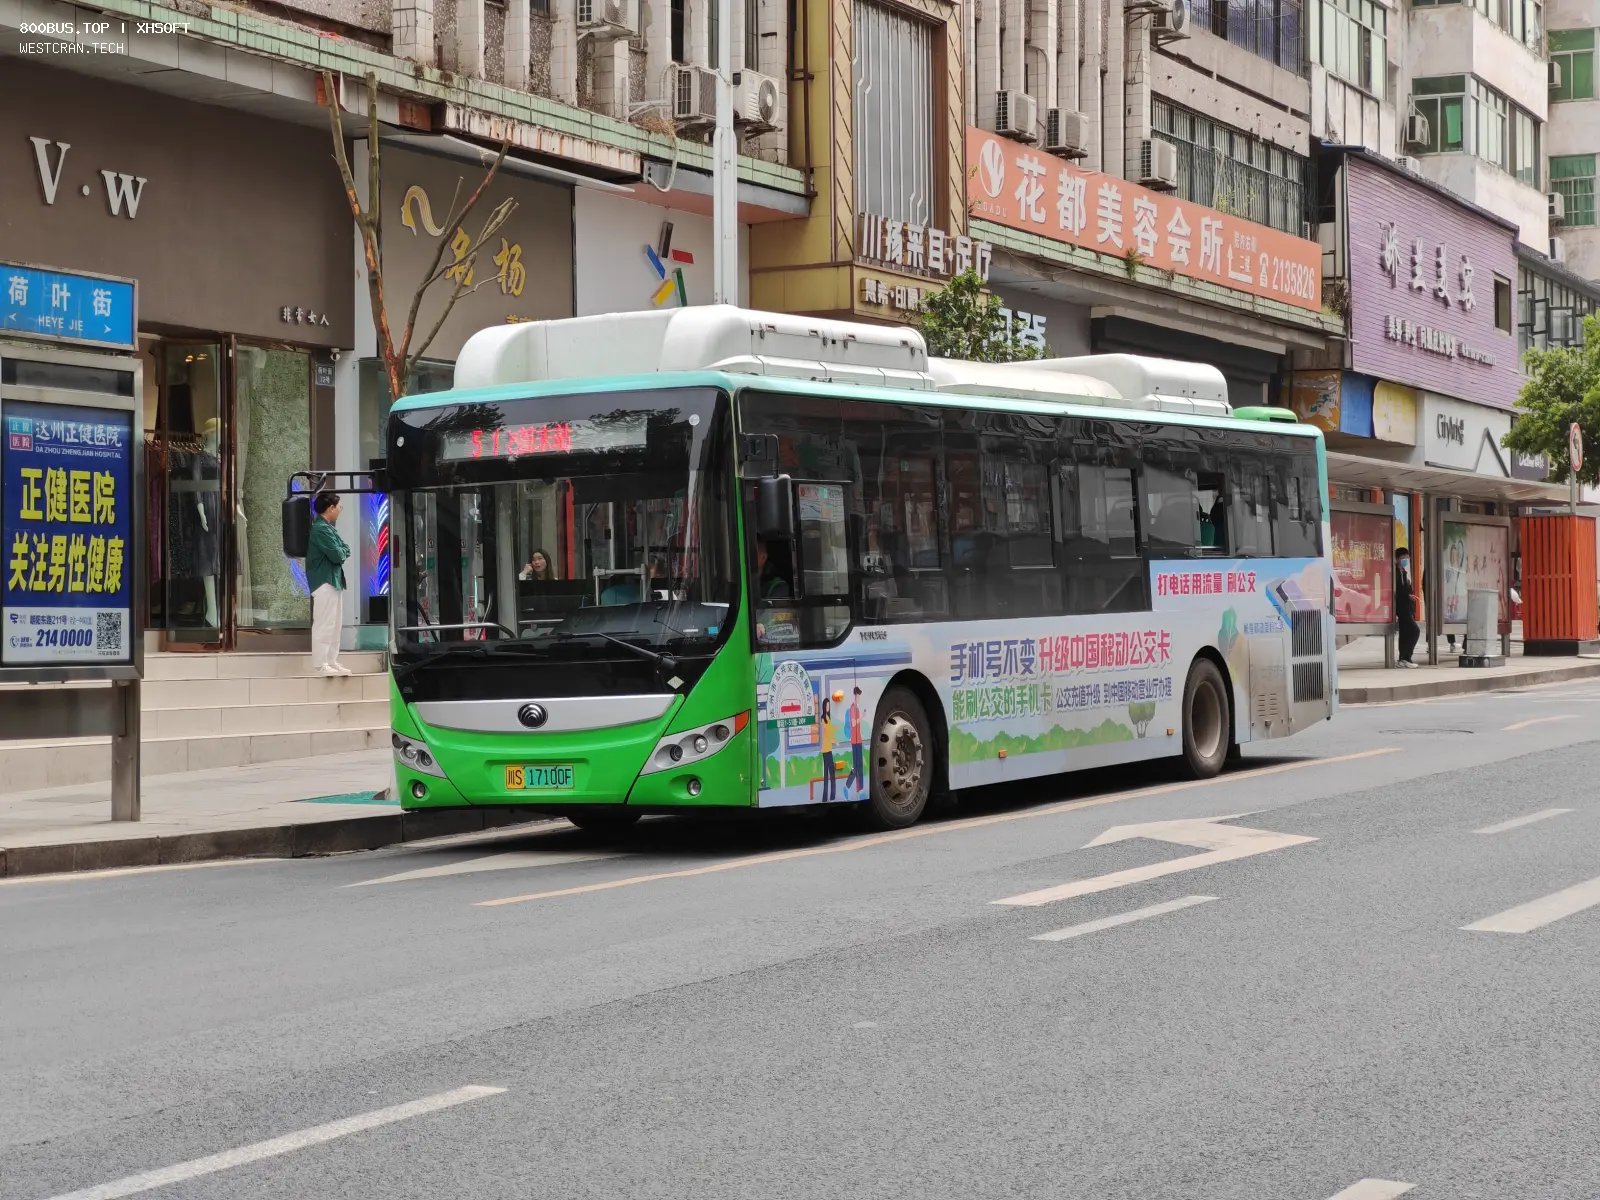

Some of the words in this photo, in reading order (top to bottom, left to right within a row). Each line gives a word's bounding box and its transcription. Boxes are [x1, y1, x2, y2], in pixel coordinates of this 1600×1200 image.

[1014, 154, 1223, 276] 花都美容会所
[8, 275, 112, 317] 荷叶街
[1272, 255, 1315, 300] 2135826
[38, 315, 64, 329] HEYE
[68, 319, 84, 331] JIE
[35, 420, 122, 447] 达州正健医院
[44, 446, 61, 454] ZHOU
[95, 451, 122, 459] HOSPITAL
[20, 466, 115, 524] 正健医院
[8, 532, 124, 593] 关注男性健康
[1157, 573, 1222, 596] 打电话用流量
[1227, 571, 1257, 593] 刷公交
[952, 682, 1053, 721] 能刷公交的手机卡
